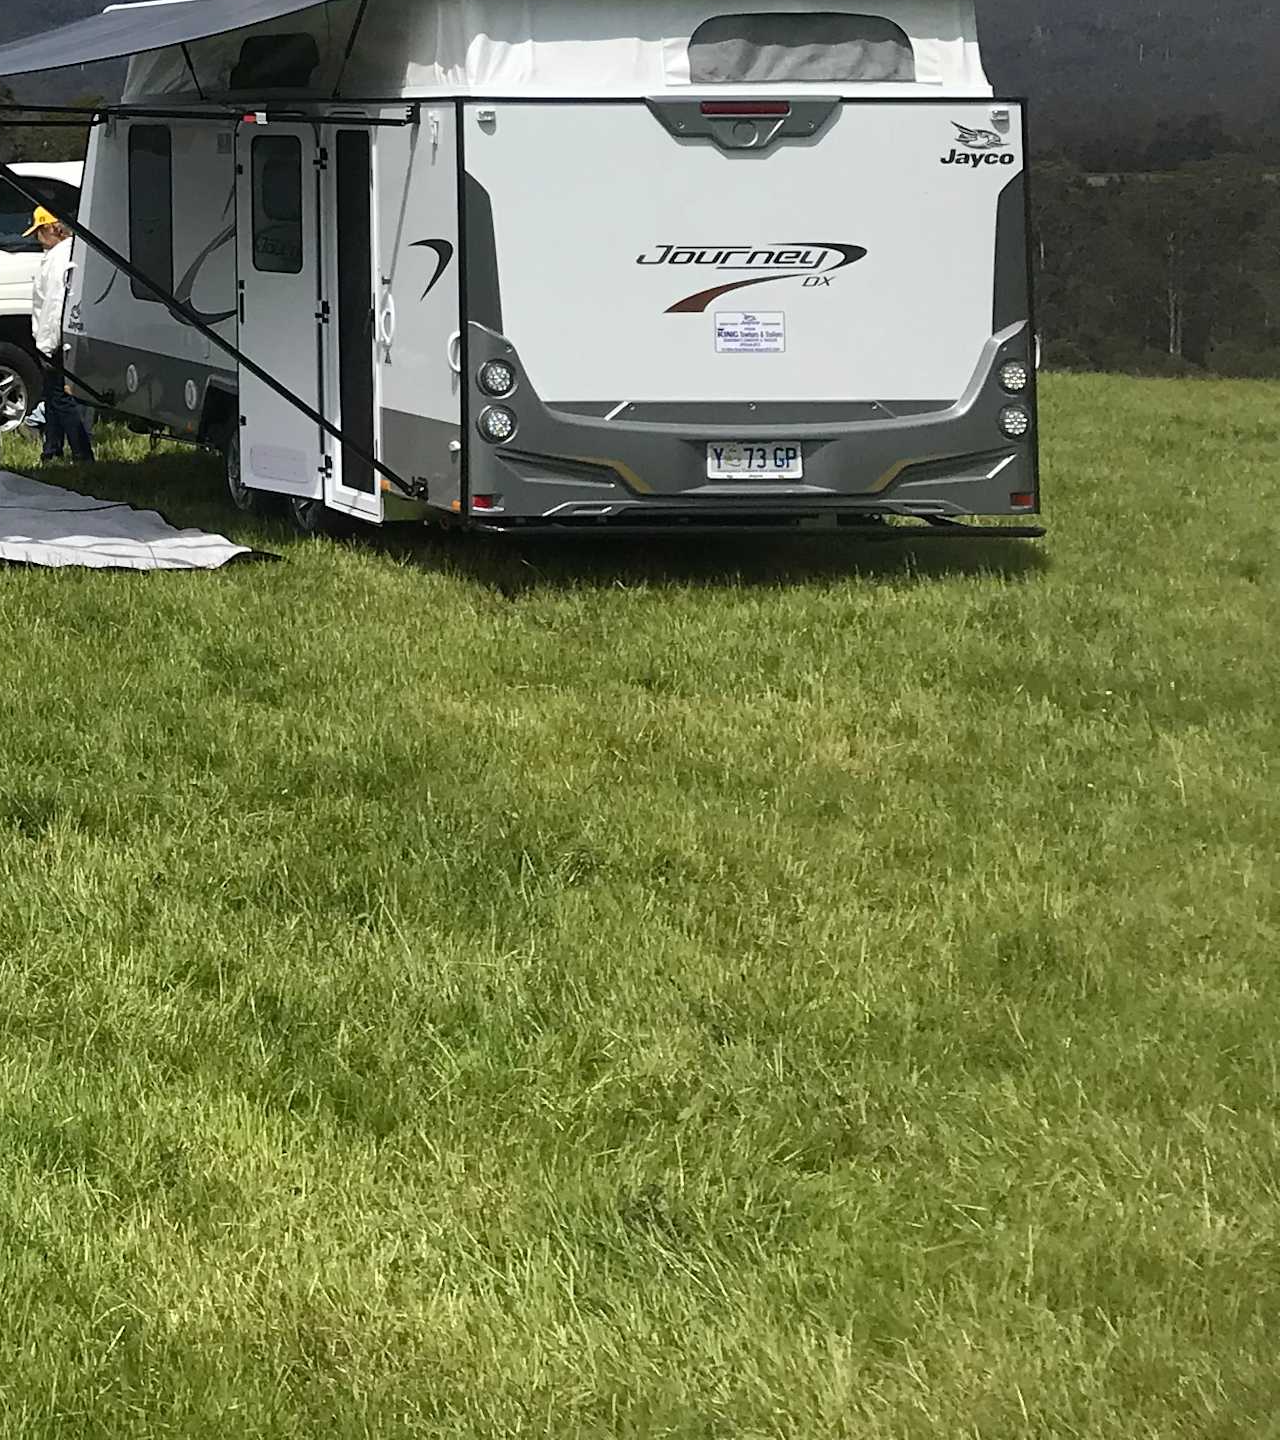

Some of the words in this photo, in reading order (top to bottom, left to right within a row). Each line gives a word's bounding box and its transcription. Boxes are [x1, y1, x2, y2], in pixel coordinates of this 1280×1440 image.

[940, 149, 1014, 168] Jayco
[636, 244, 829, 269] Journey
[801, 276, 836, 287] DX
[713, 448, 724, 468] Y
[743, 448, 767, 468] 73
[774, 448, 797, 468] GP
